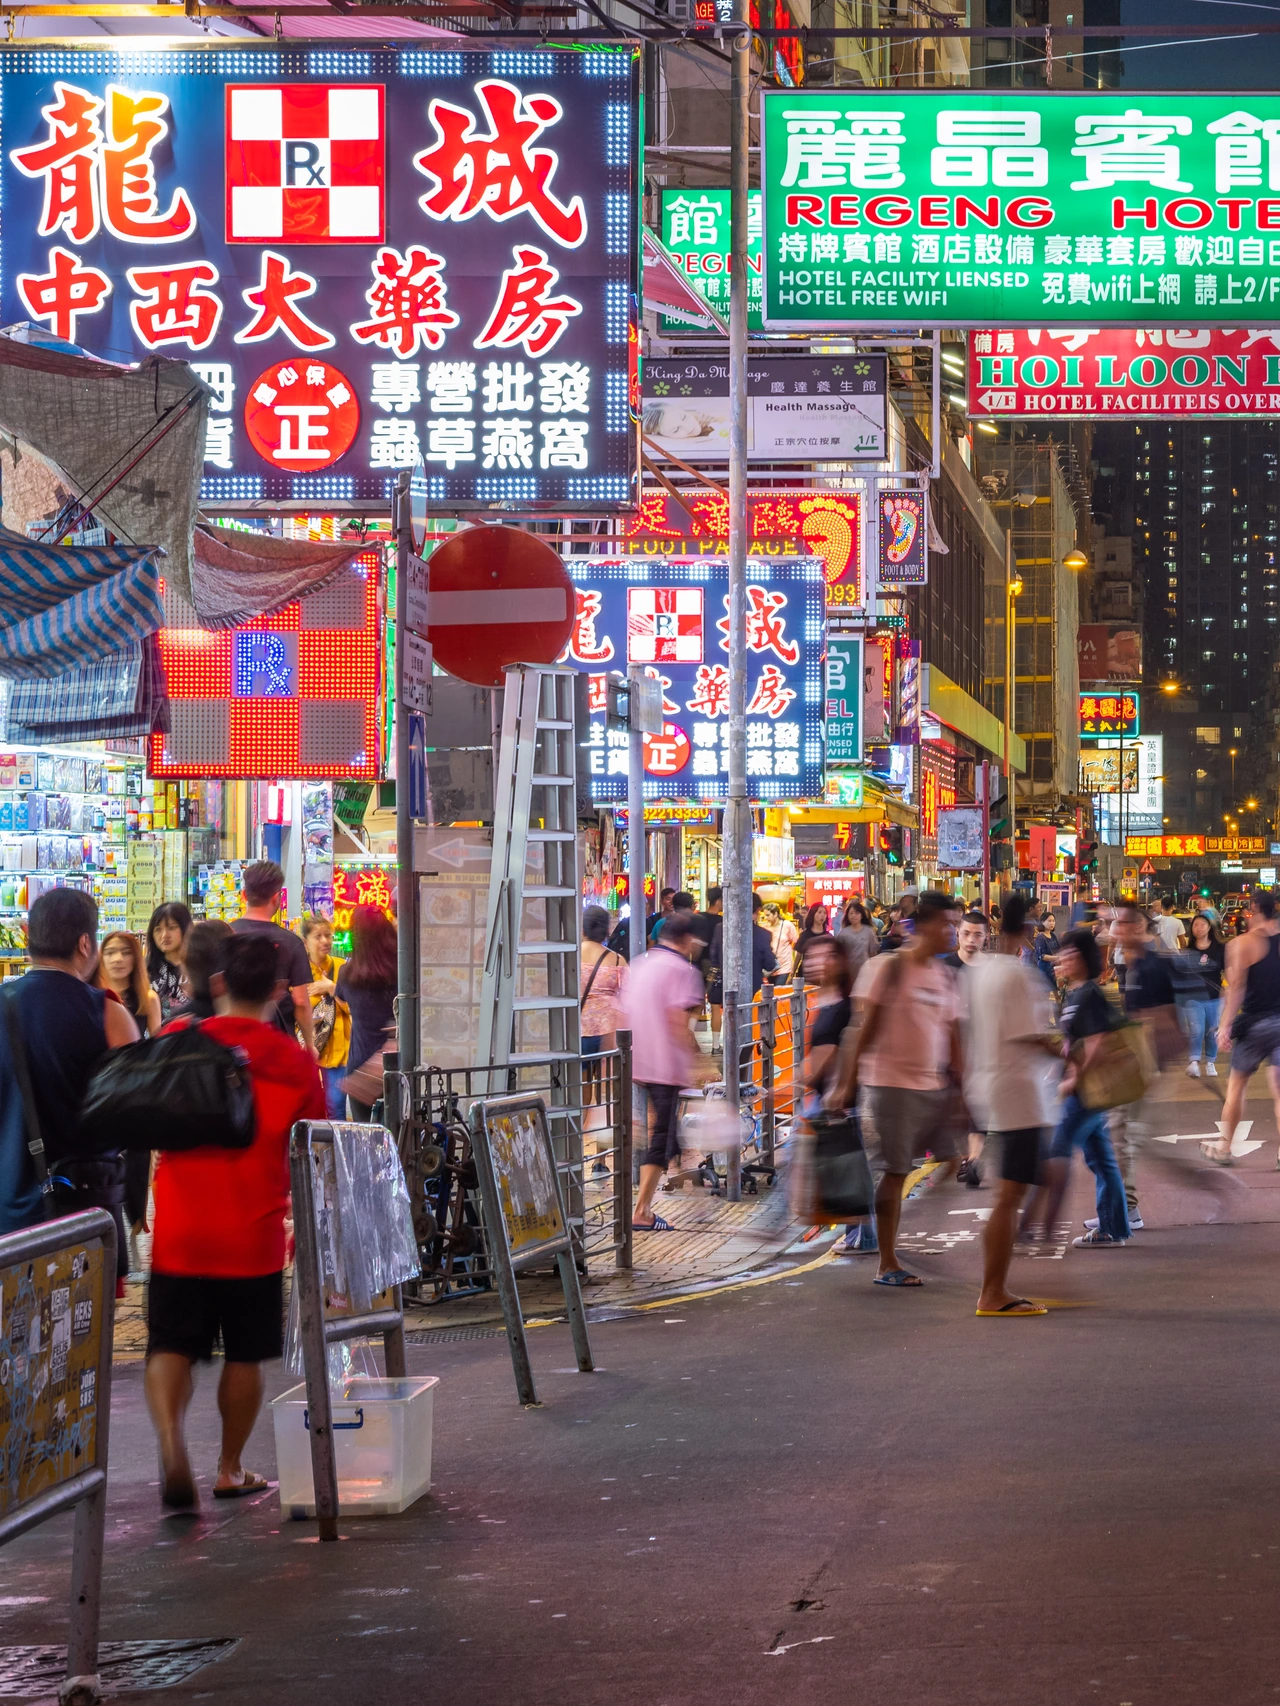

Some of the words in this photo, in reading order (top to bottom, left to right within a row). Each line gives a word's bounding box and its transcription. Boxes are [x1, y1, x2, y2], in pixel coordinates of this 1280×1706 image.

[786, 194, 1055, 229] REGENG
[779, 234, 901, 265] 持牌賓館
[911, 234, 1034, 265] 酒店設備
[1044, 235, 1166, 266] 豪華套房
[779, 271, 846, 287] HOTEL
[851, 271, 942, 287] FACILITY
[946, 271, 1030, 288] LIENSED
[17, 245, 582, 358] 中西大藥房
[779, 289, 848, 305] HOTEL
[851, 289, 899, 305] FREE
[903, 290, 947, 306] WIFI
[370, 361, 590, 413] 專營批發
[977, 355, 1084, 388] HOI
[1095, 354, 1258, 388] LOON
[766, 402, 802, 412] Health
[807, 402, 856, 413] Massage
[1023, 394, 1097, 411] HOTEL
[1100, 394, 1221, 410] FACILITEIS
[272, 405, 331, 459] 正
[858, 435, 878, 445] 1/F
